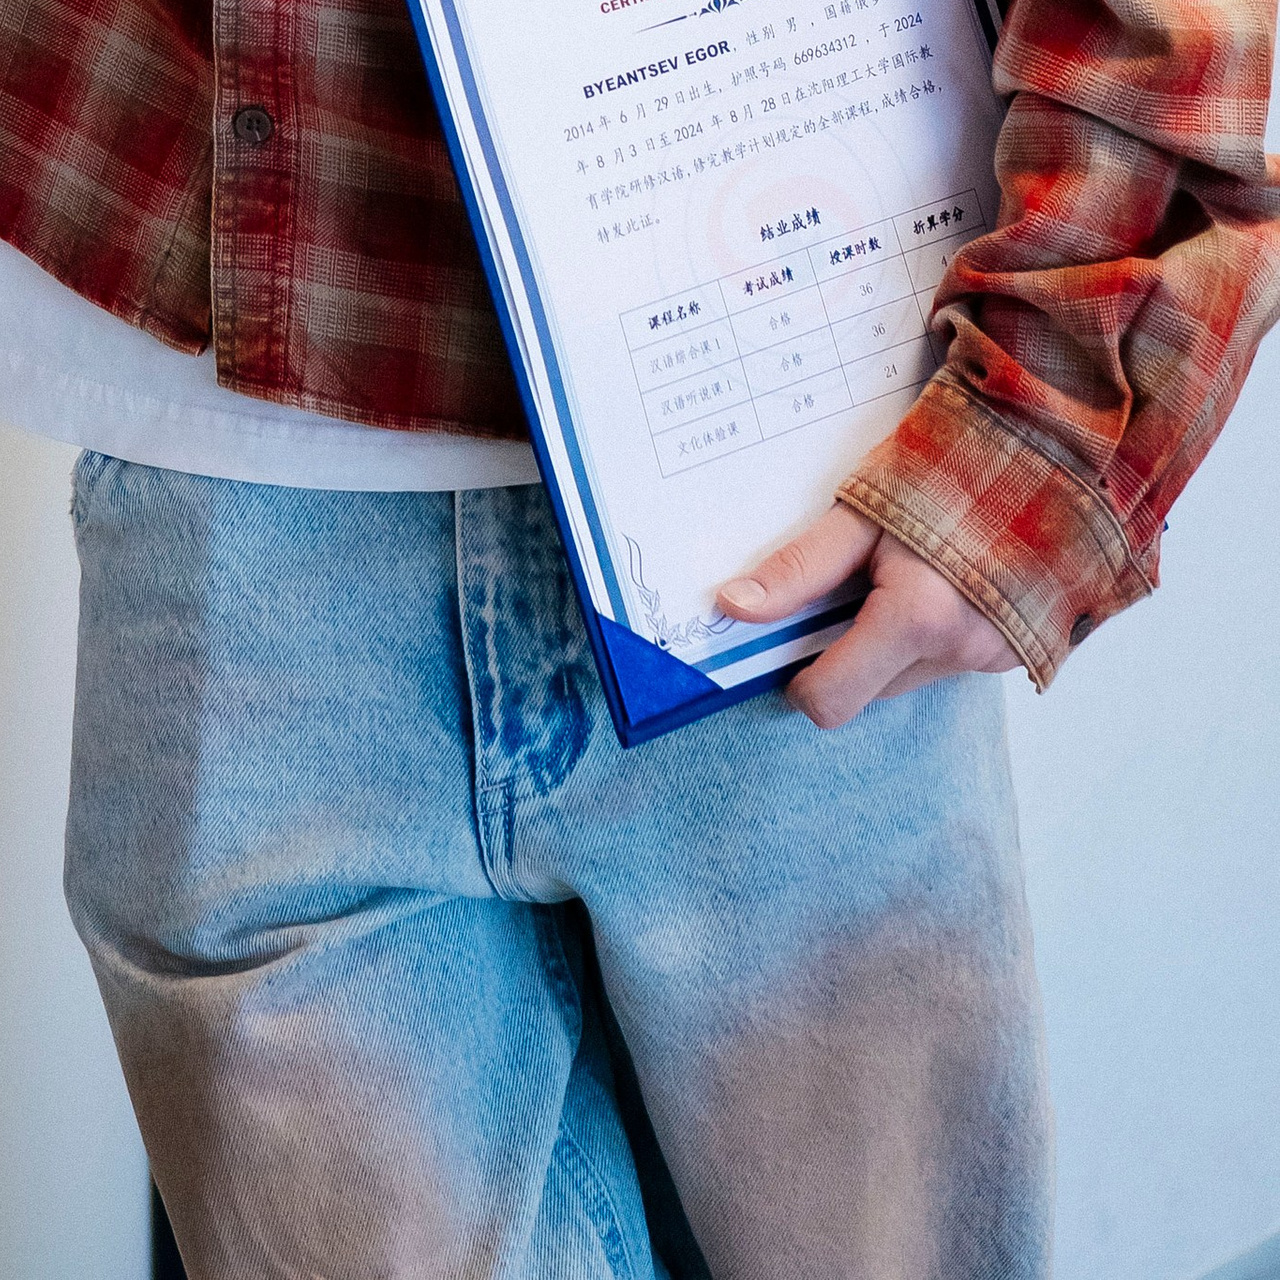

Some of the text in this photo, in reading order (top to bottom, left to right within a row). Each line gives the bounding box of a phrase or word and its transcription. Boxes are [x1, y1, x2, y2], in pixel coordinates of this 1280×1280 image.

[582, 56, 678, 99] BYEANTSEV
[745, 23, 776, 46] 性别
[785, 16, 797, 33] 男
[563, 121, 594, 143] 2014
[654, 96, 669, 112] 29
[793, 33, 858, 66] 669634312
[893, 12, 923, 33] 2024
[673, 121, 704, 143] 2024
[760, 96, 777, 113] 28
[760, 207, 821, 242] 结业成绩
[913, 206, 964, 235] 折算学分
[829, 236, 882, 266] 授课时数
[745, 266, 794, 296] 考试成绩
[859, 282, 874, 297] 36
[648, 300, 701, 330] 课程名称
[769, 312, 791, 331] 合格
[871, 322, 886, 338] 36
[781, 352, 803, 372] 合格
[883, 363, 898, 379] 24
[792, 393, 815, 414] 合格
